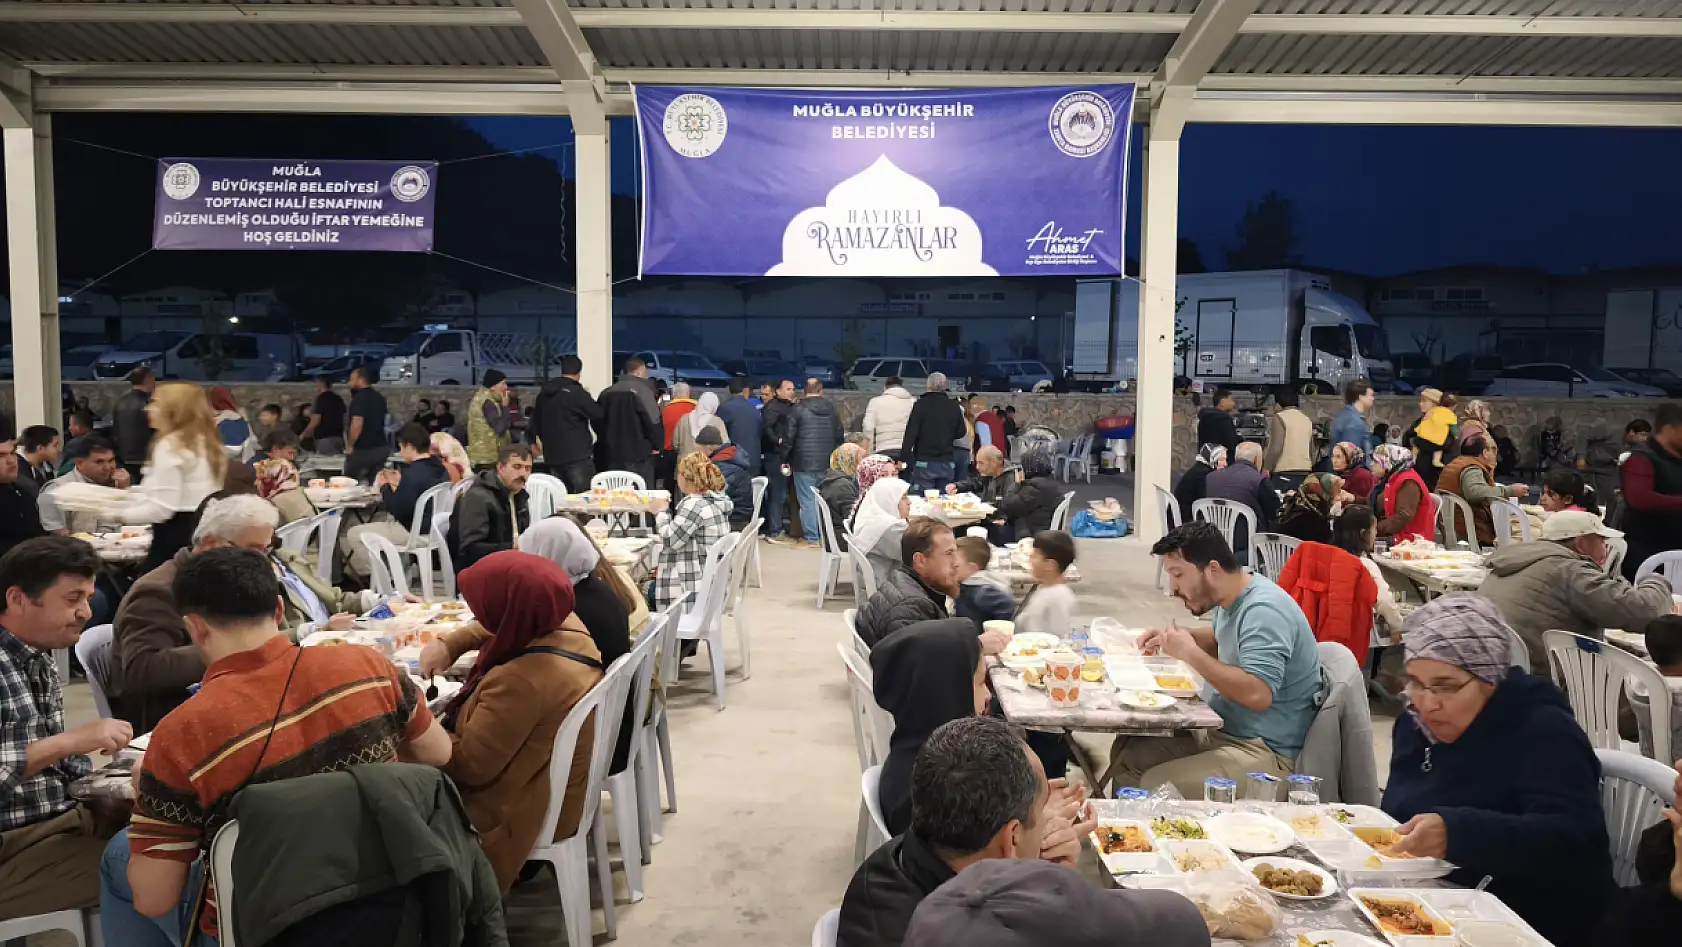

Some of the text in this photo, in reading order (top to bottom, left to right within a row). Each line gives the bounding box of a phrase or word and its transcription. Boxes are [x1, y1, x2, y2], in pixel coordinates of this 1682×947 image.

[792, 101, 976, 121] MUĞLA BÜYÜKŞEHİR
[831, 121, 936, 140] BELEDİYESİ
[272, 163, 322, 177] MUĞLA
[211, 178, 298, 196] BÜYÜKŞEHİR
[299, 180, 380, 194] BELEDİYESİ
[205, 195, 384, 210] TOPTANCI HALİ ESNAFININ
[163, 211, 425, 229] DÜZENLEMİŞ OLDUĞU İFTAR YEMEĞİNE
[848, 209, 921, 224] HAYIRLI
[243, 228, 340, 246] HOŞ GELDİNİZ
[806, 220, 958, 266] RAMAZANLAR
[1025, 220, 1104, 253] Ahmet
[1050, 243, 1080, 254] ARAS
